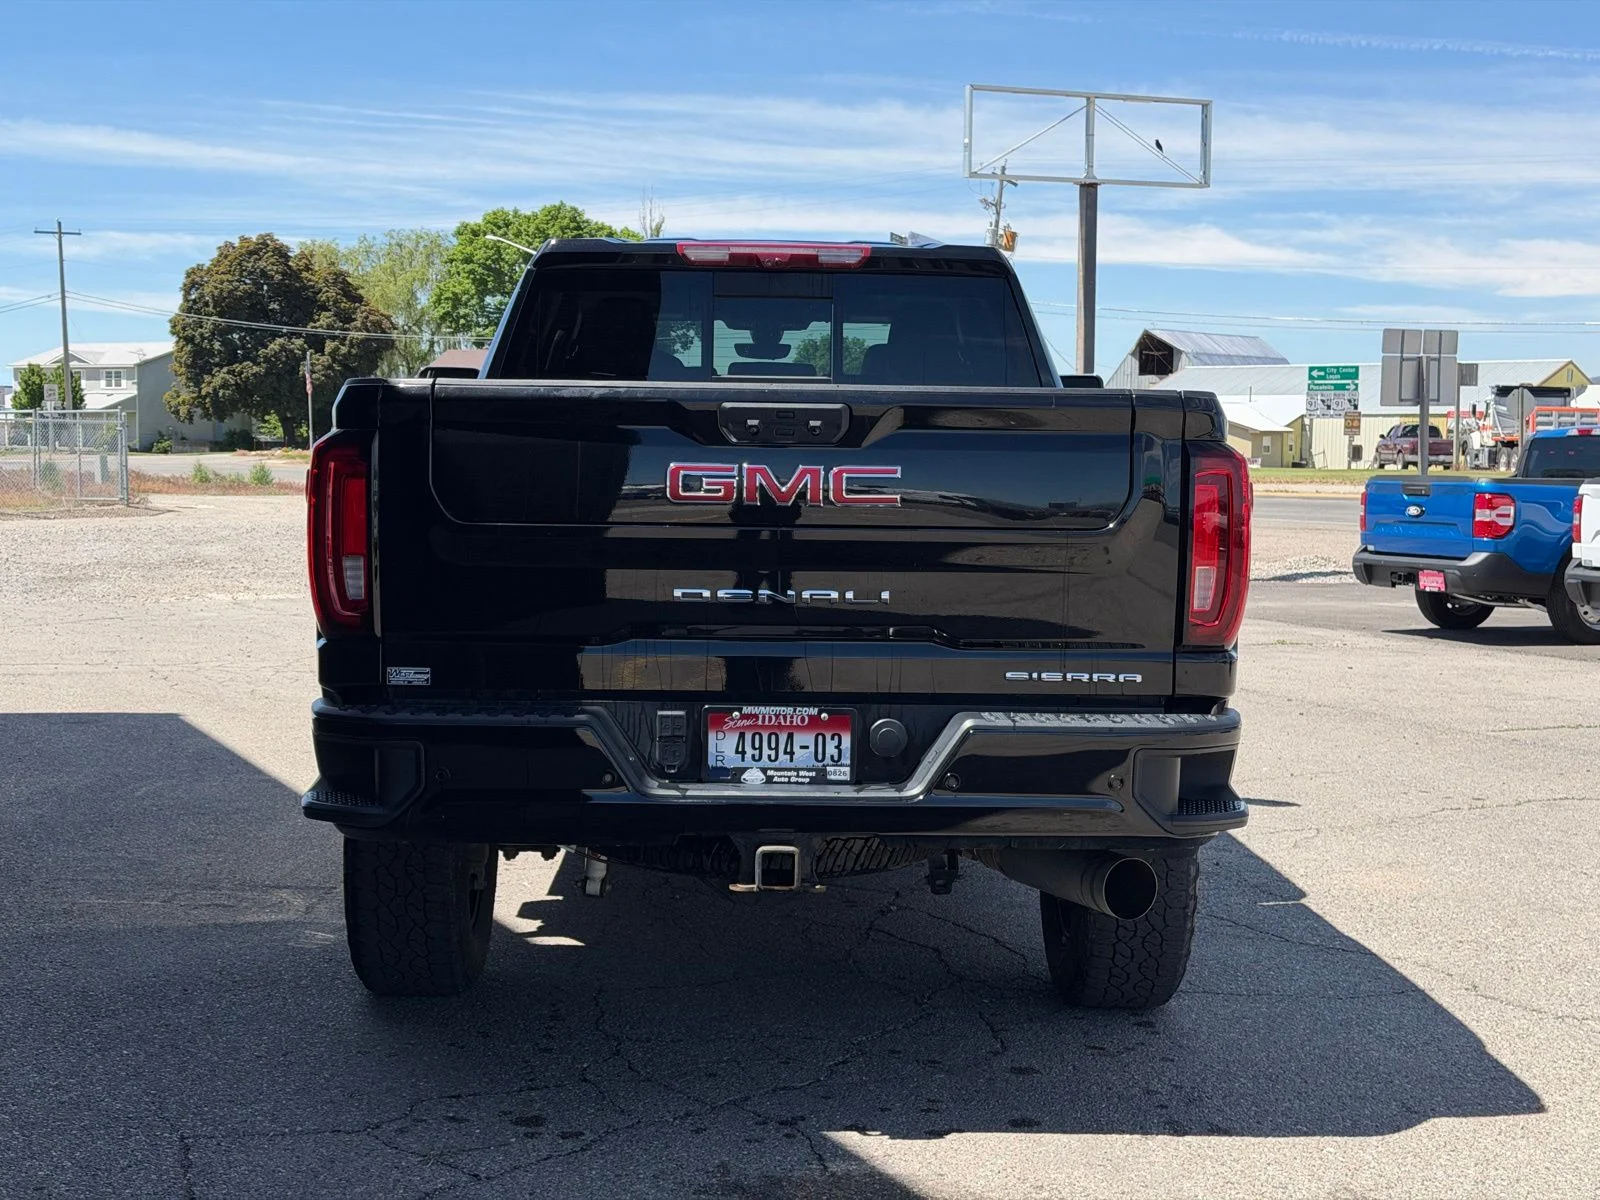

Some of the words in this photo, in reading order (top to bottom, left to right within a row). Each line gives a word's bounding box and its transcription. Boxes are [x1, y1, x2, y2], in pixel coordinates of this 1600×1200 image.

[1307, 400, 1317, 408] 91
[1334, 400, 1344, 408] 91
[666, 462, 902, 507] GMC
[673, 588, 890, 604] DENALI
[1005, 671, 1143, 683] SIERRA
[741, 706, 819, 716] MWMOTOR.COM
[722, 716, 758, 730] Scenic
[757, 715, 809, 726] IDAHO
[734, 731, 843, 763] 4994-03
[766, 769, 797, 777] Mountain
